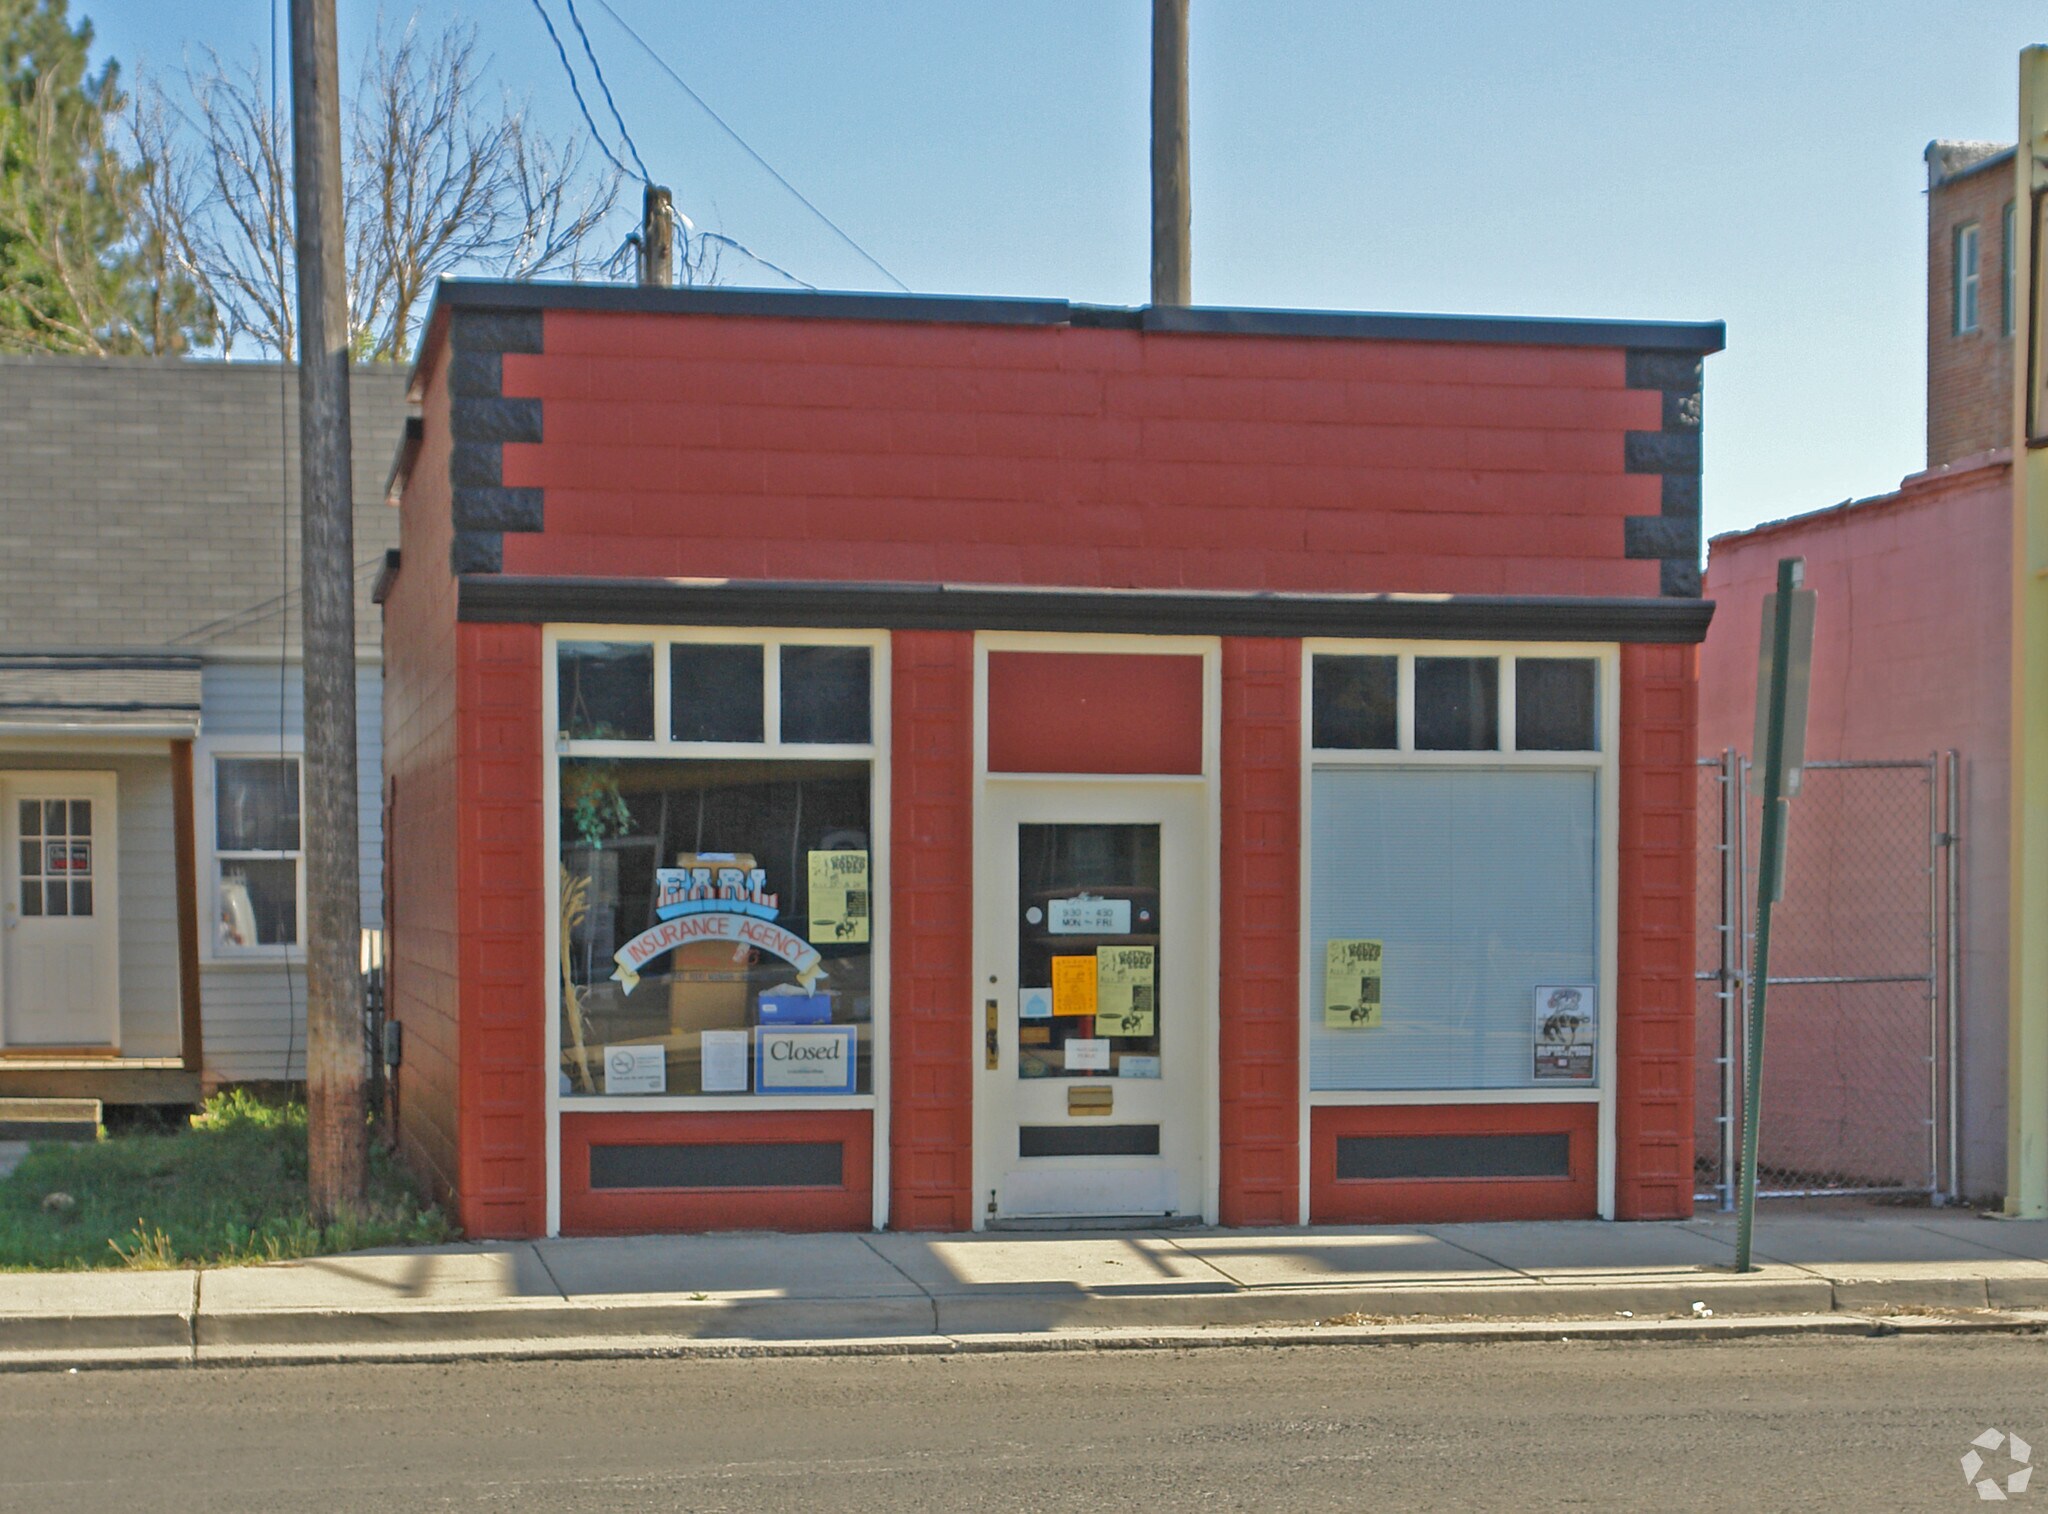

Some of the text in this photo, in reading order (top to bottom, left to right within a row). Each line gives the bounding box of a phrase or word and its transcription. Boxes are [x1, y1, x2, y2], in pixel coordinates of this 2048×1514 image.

[656, 867, 779, 909] EARL
[1062, 918, 1081, 927] MON
[628, 917, 810, 963] INSURANCE AGENCY
[770, 1039, 840, 1061] Closed
